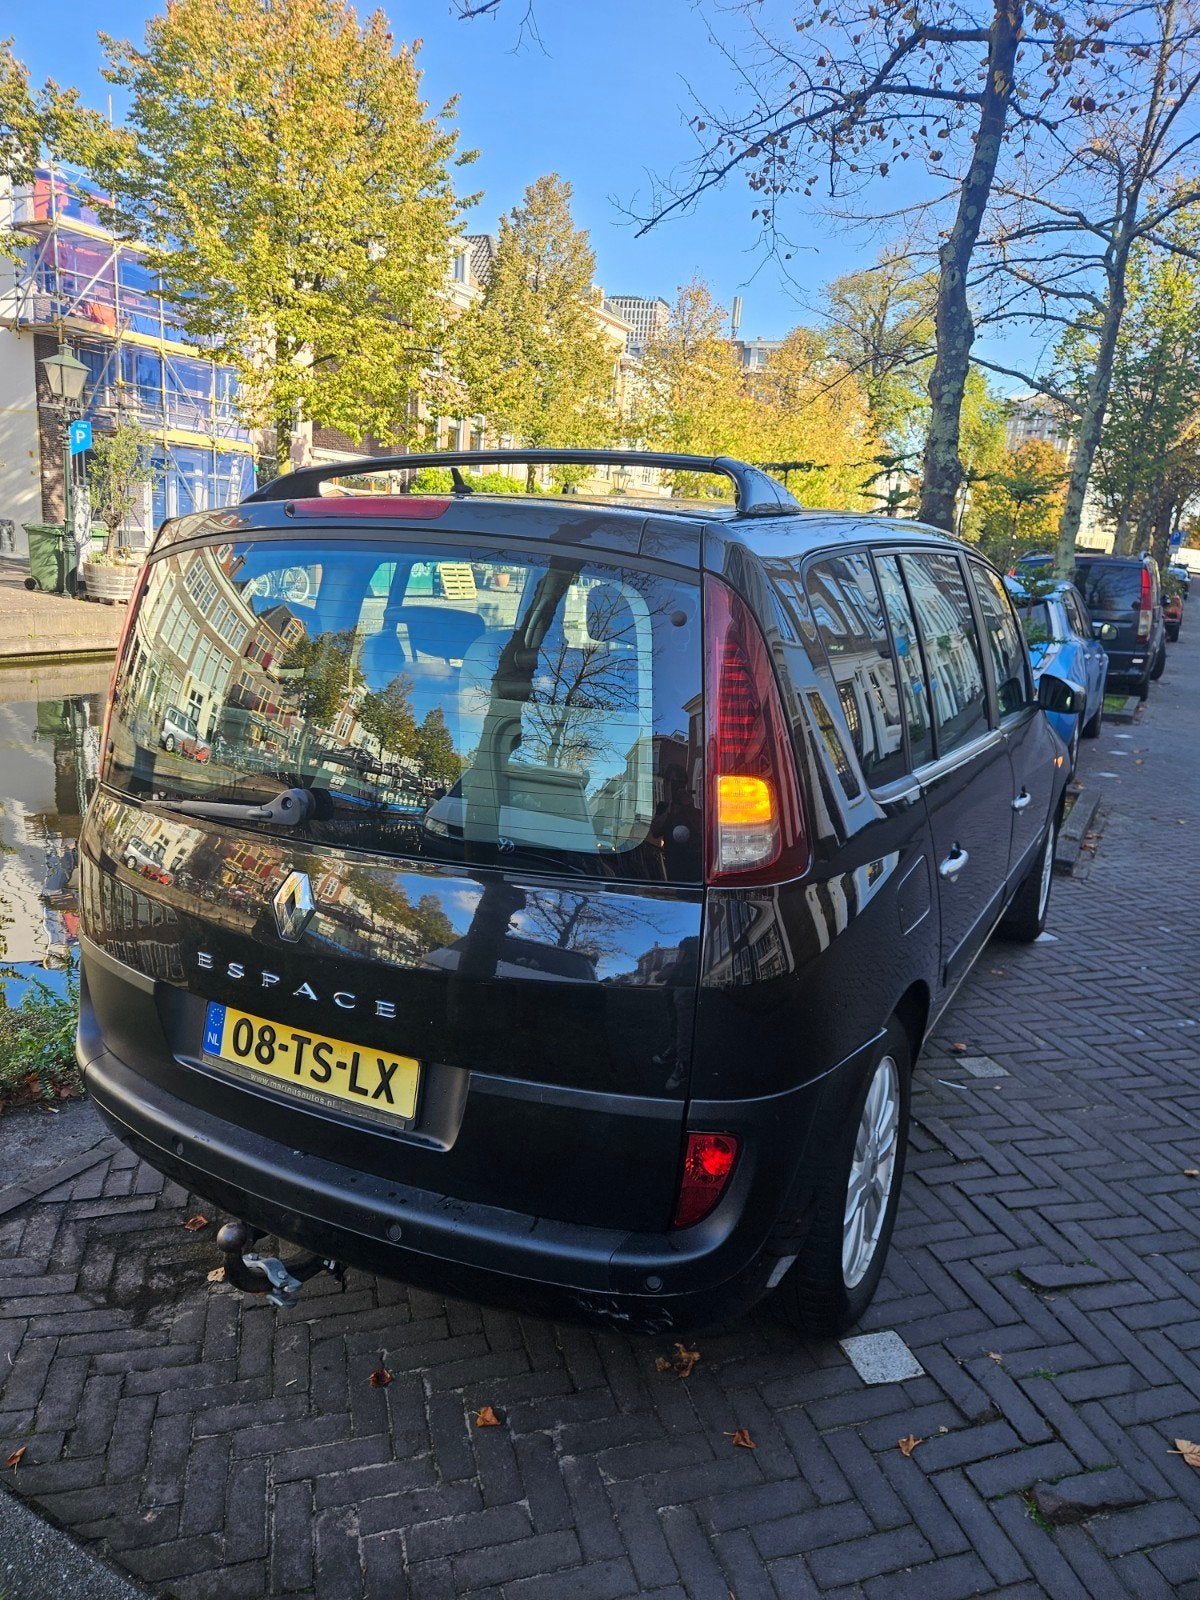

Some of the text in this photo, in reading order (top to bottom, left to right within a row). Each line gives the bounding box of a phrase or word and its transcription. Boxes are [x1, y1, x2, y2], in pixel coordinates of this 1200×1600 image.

[76, 430, 86, 444] P
[197, 951, 397, 1019] ESPACE
[207, 1031, 219, 1047] NL
[232, 1017, 399, 1105] 08-TS-LX
